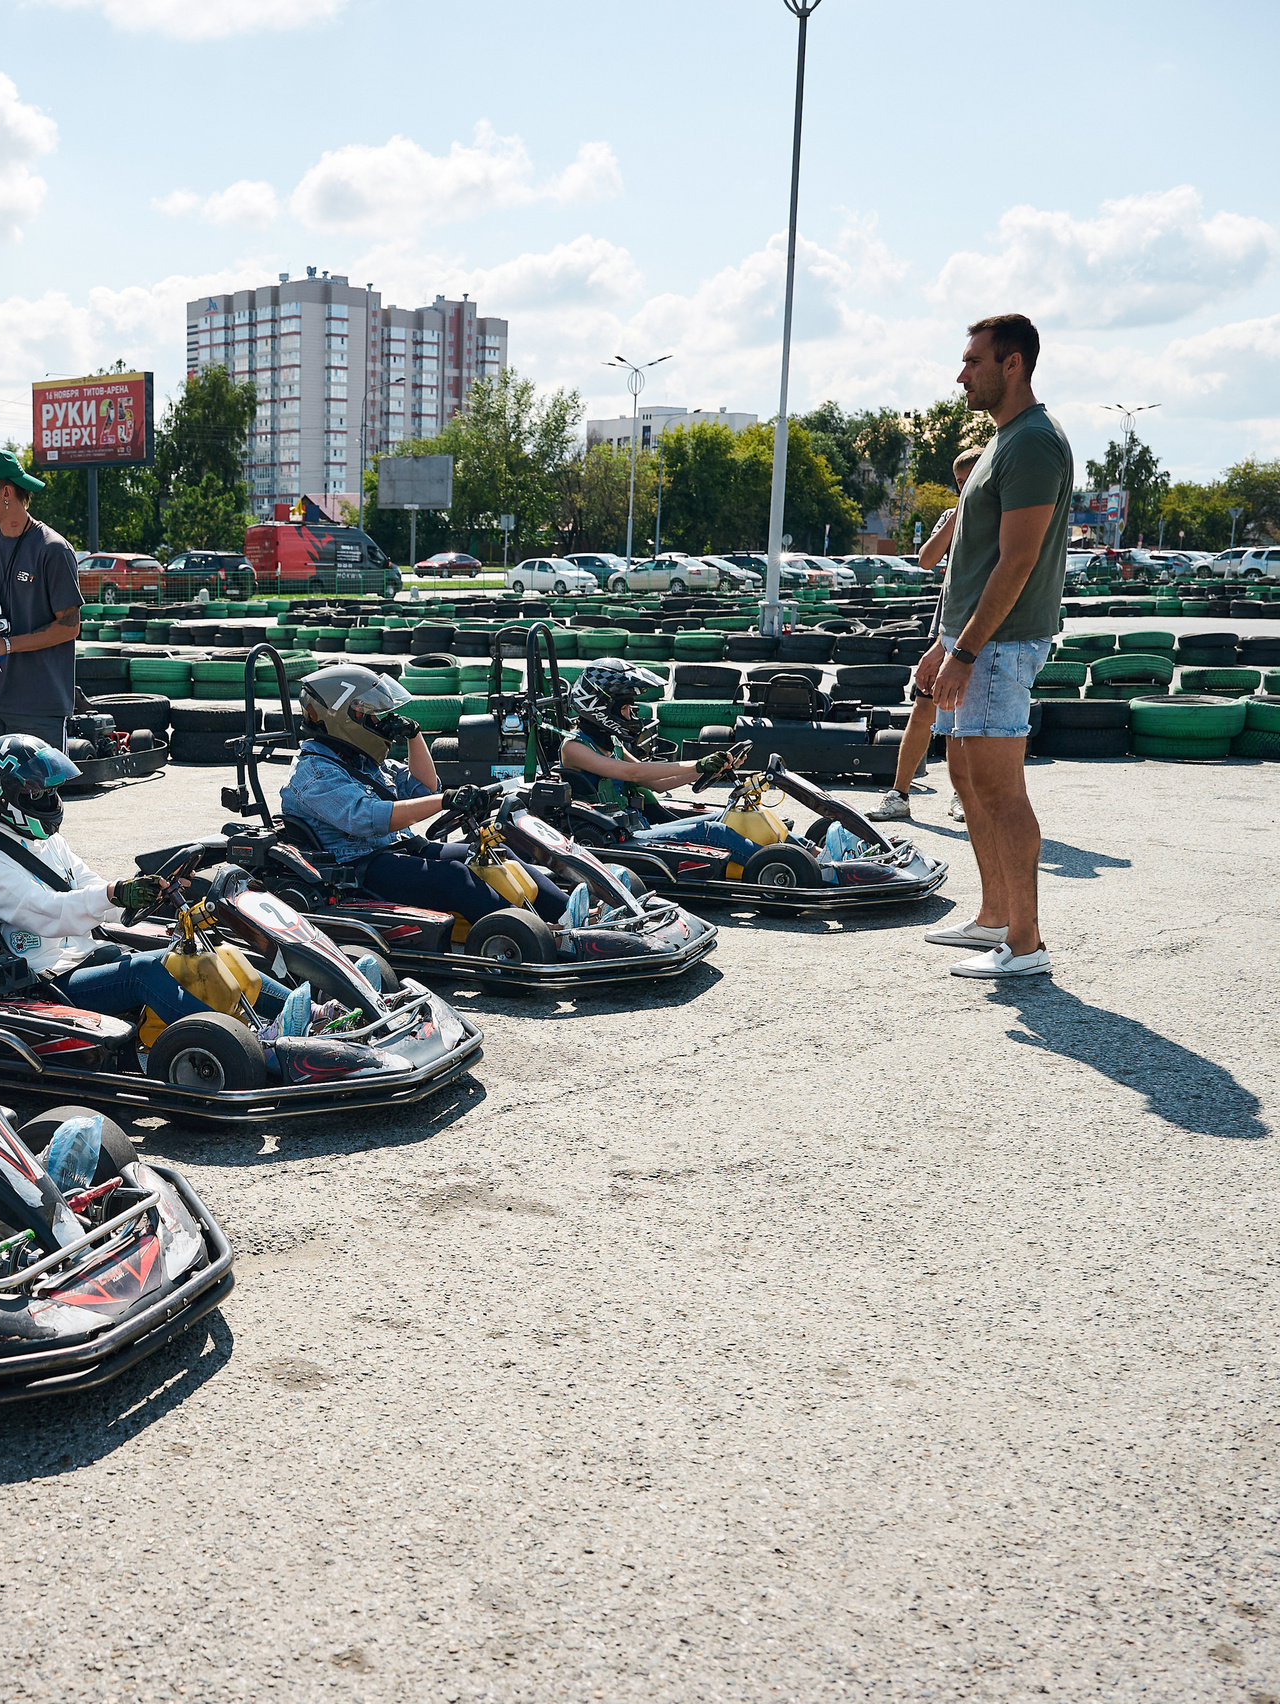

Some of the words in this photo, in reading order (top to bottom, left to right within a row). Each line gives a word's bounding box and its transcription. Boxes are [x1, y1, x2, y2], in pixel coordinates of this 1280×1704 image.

[54, 389, 79, 399] НОЯБРЯ
[83, 385, 129, 397] ТИТОВ-АРЕНА
[42, 400, 97, 428] РУКИ
[42, 426, 97, 448] ВВЕРХ!
[331, 681, 357, 711] 7
[591, 711, 623, 735] RACIN
[533, 821, 561, 842] 3
[258, 902, 296, 929] 2
